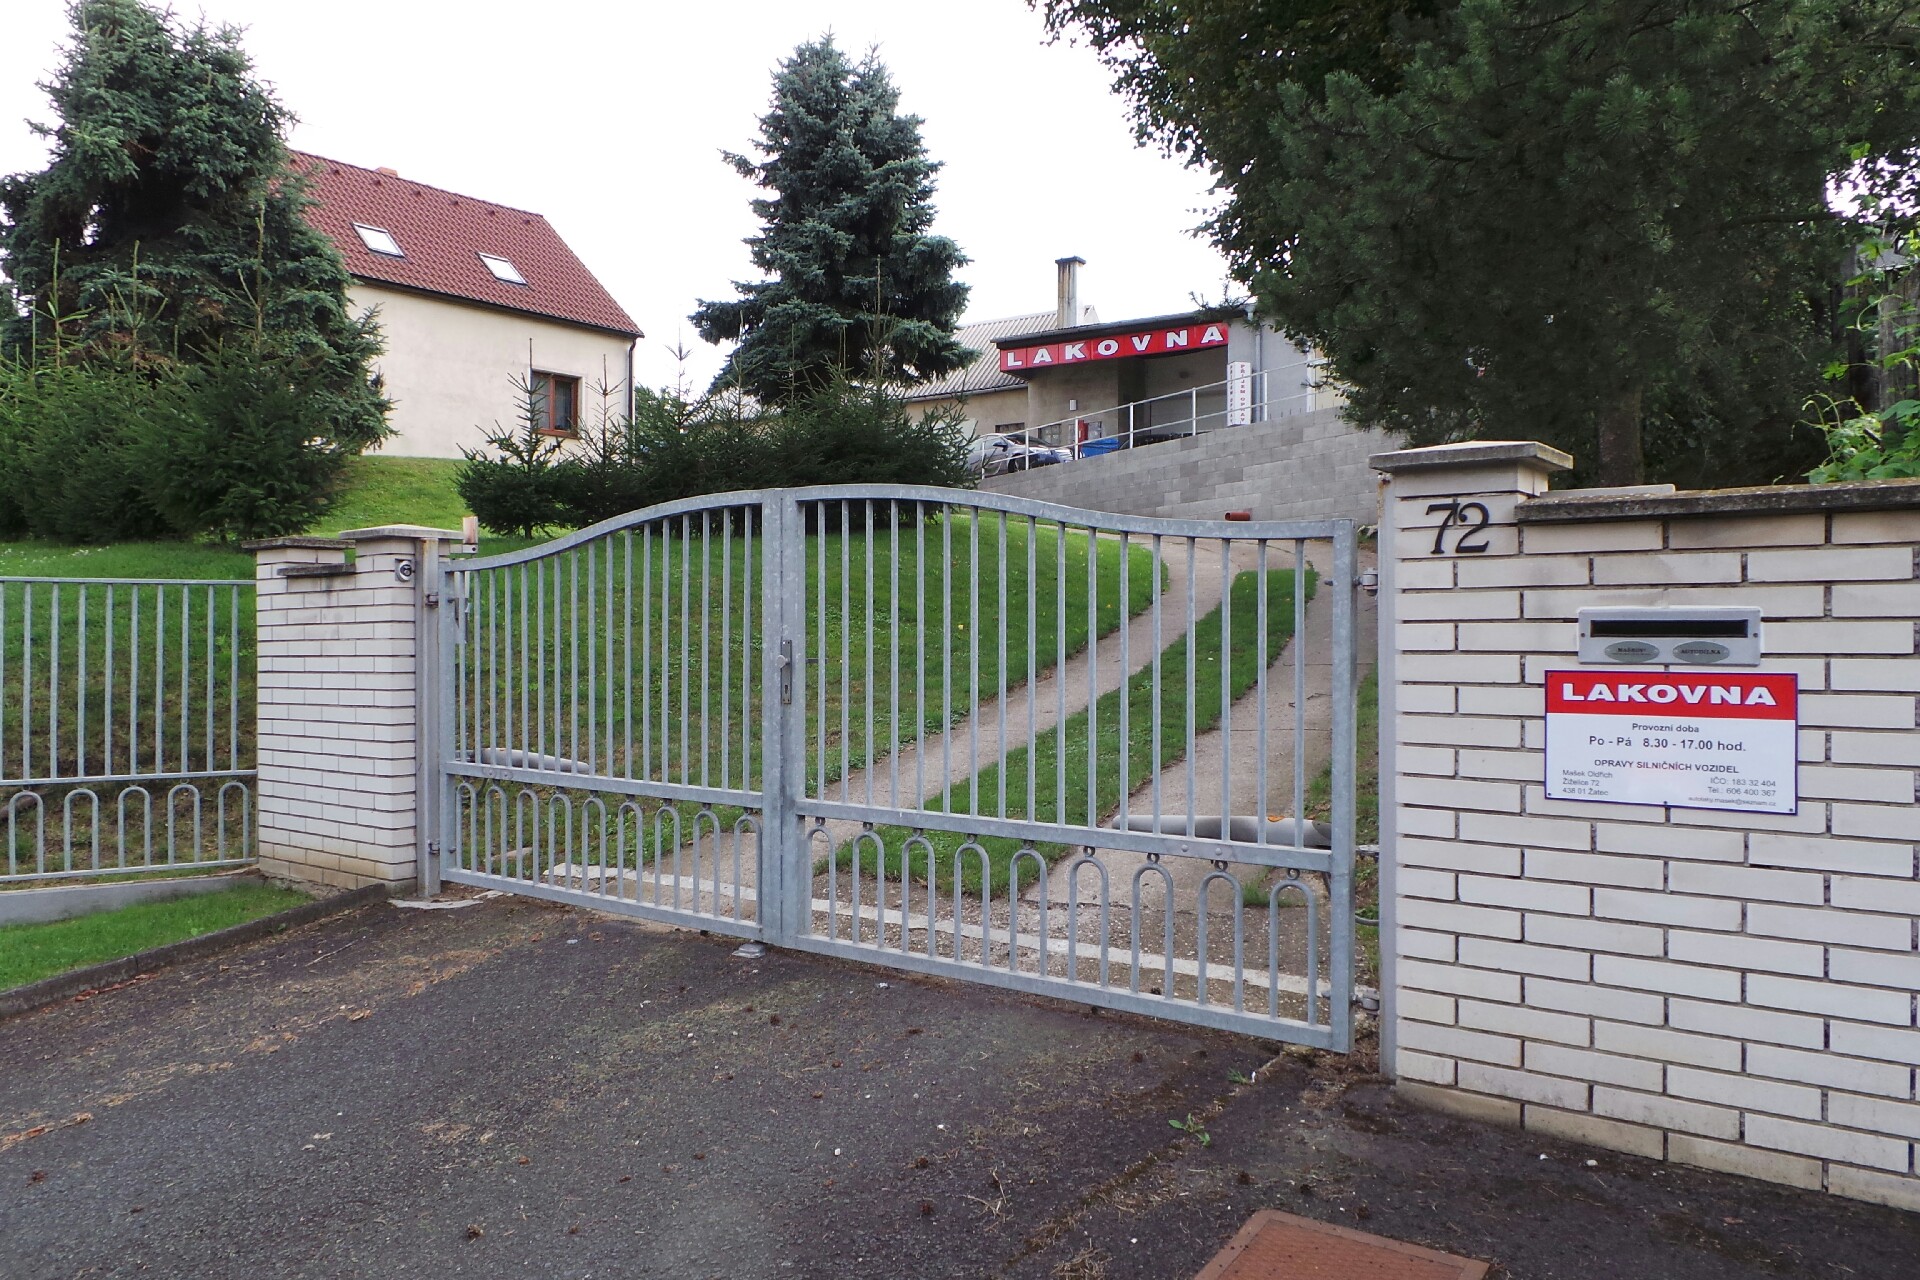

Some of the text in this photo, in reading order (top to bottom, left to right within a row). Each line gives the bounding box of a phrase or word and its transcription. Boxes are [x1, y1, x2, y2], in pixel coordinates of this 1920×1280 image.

[1007, 326, 1224, 367] LAKOVNA
[1425, 502, 1490, 554] 72
[1562, 683, 1777, 706] LAKOVNA
[1632, 723, 1700, 733] Provozní doba
[1589, 736, 1605, 746] Po
[1616, 736, 1632, 747] Pá
[1643, 738, 1668, 748] 8.30
[1680, 739, 1713, 750] 17.00
[1717, 740, 1746, 752] hod.
[1594, 759, 1740, 774] OPRAVY SILNIČNÍCH VOZIDEL
[1562, 769, 1613, 778] Mašek Oldřich
[1591, 779, 1600, 787] 72
[1710, 776, 1729, 785] IČO:
[1732, 778, 1746, 786] 183
[1749, 779, 1759, 787] 32
[1587, 787, 1609, 796] Žatec
[1726, 787, 1741, 795] 606
[1743, 788, 1759, 796] 400
[1761, 789, 1776, 797] 367
